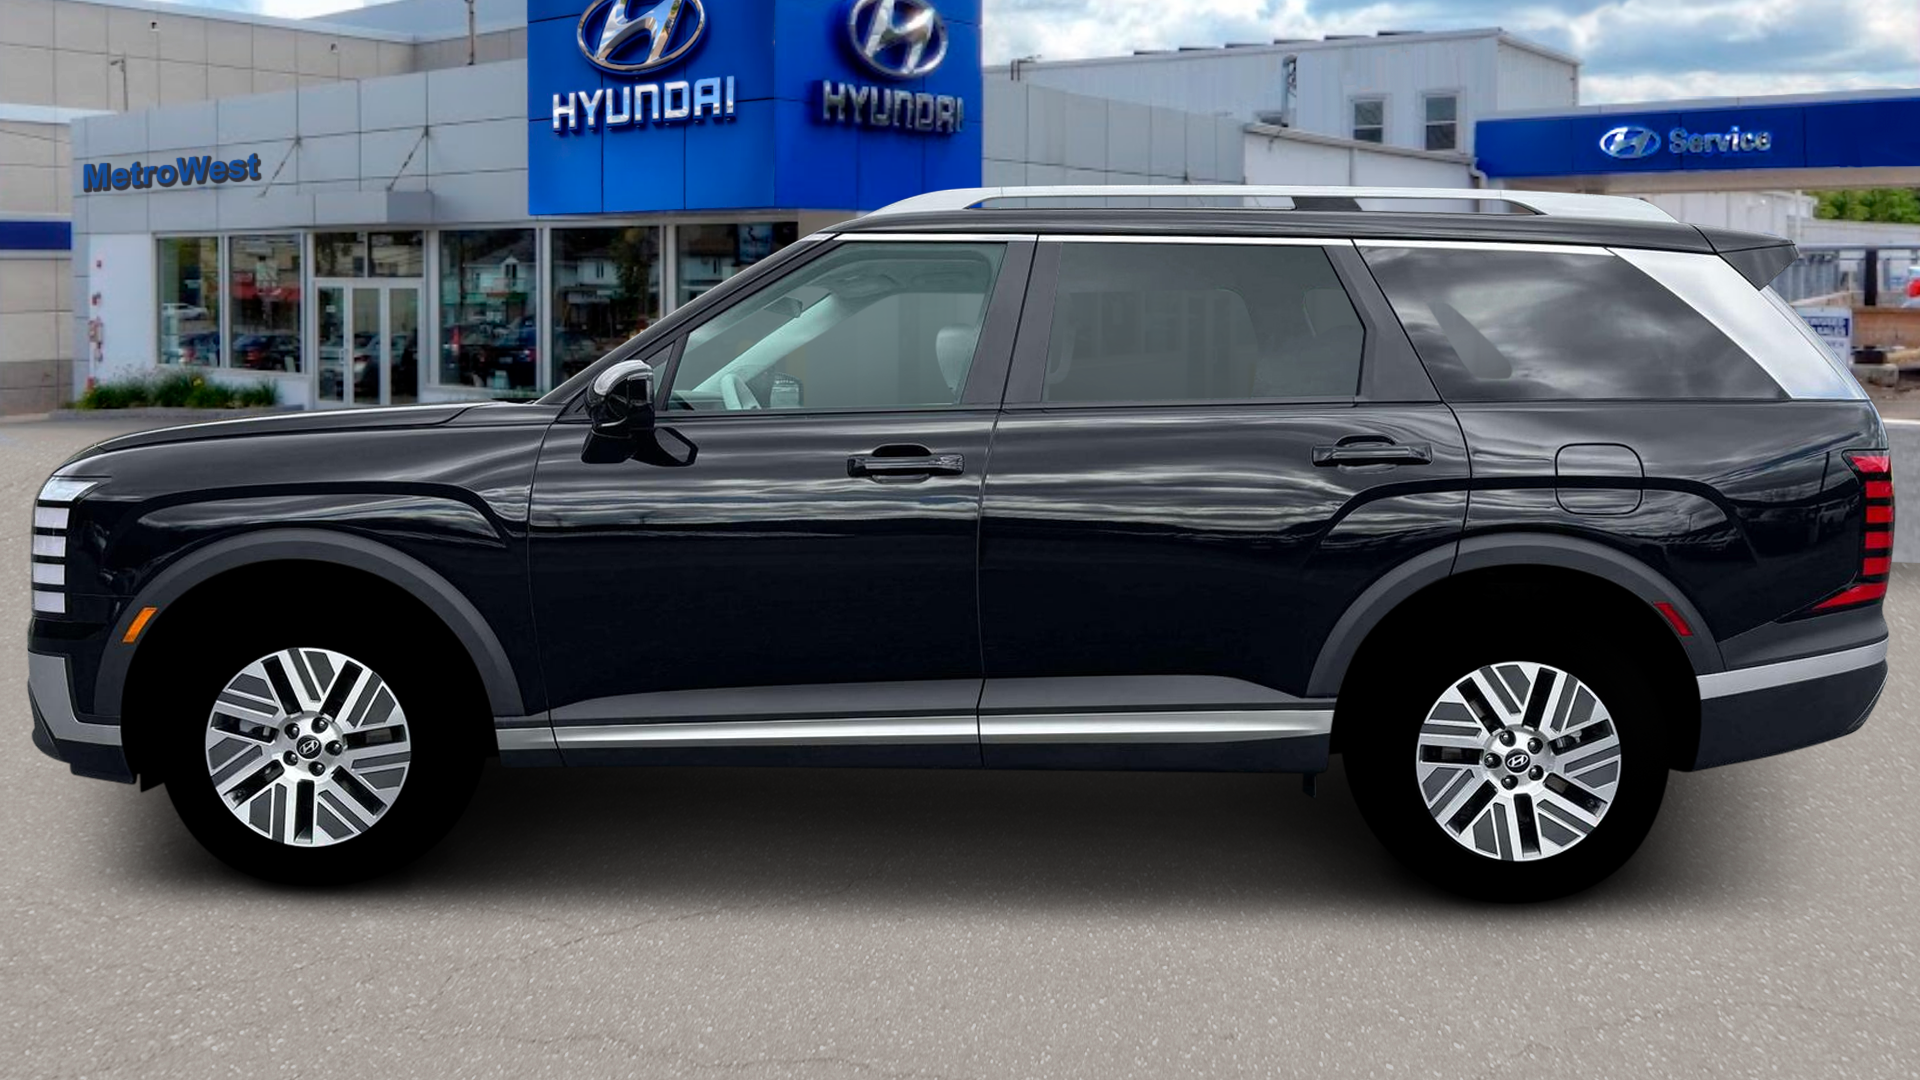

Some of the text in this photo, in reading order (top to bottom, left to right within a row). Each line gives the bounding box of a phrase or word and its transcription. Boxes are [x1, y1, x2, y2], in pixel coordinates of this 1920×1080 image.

[552, 75, 735, 130] HYUNDAI
[822, 79, 965, 133] HYUNDAI
[1668, 125, 1772, 154] Service
[83, 153, 262, 193] MetroWest
